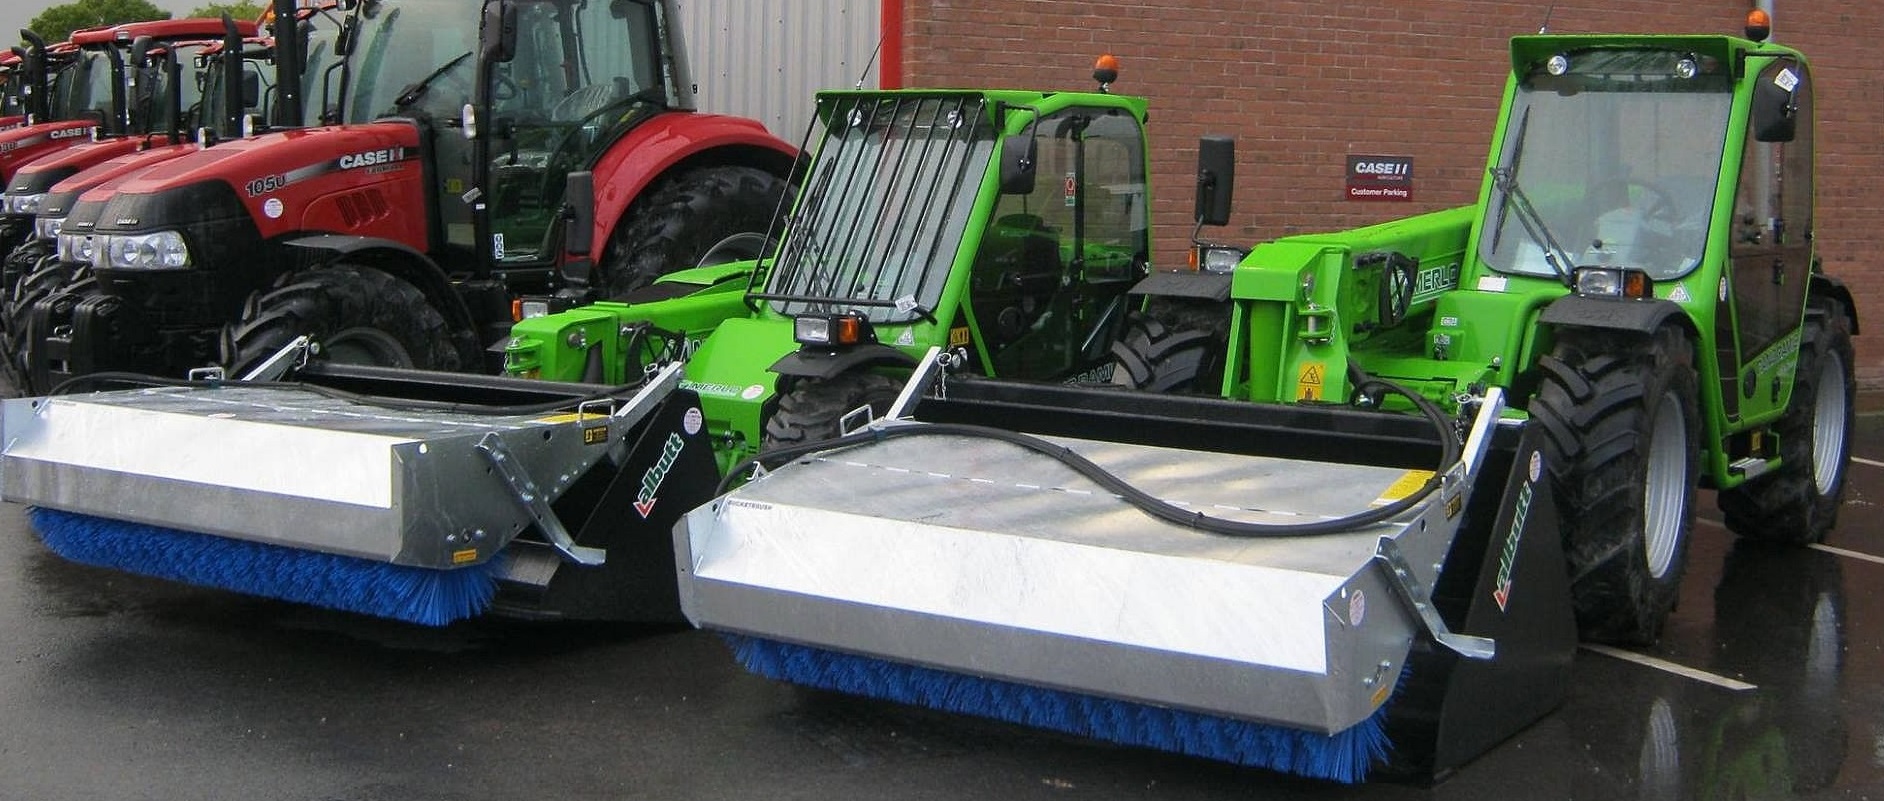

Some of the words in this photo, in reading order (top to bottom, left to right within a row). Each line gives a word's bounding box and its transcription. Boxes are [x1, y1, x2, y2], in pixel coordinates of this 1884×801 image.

[340, 150, 388, 169] CASE
[245, 174, 286, 198] 105U
[1351, 188, 1382, 196] Customer
[1384, 188, 1408, 198] Parking
[637, 432, 685, 507] albutt
[1496, 480, 1533, 594] albutt
